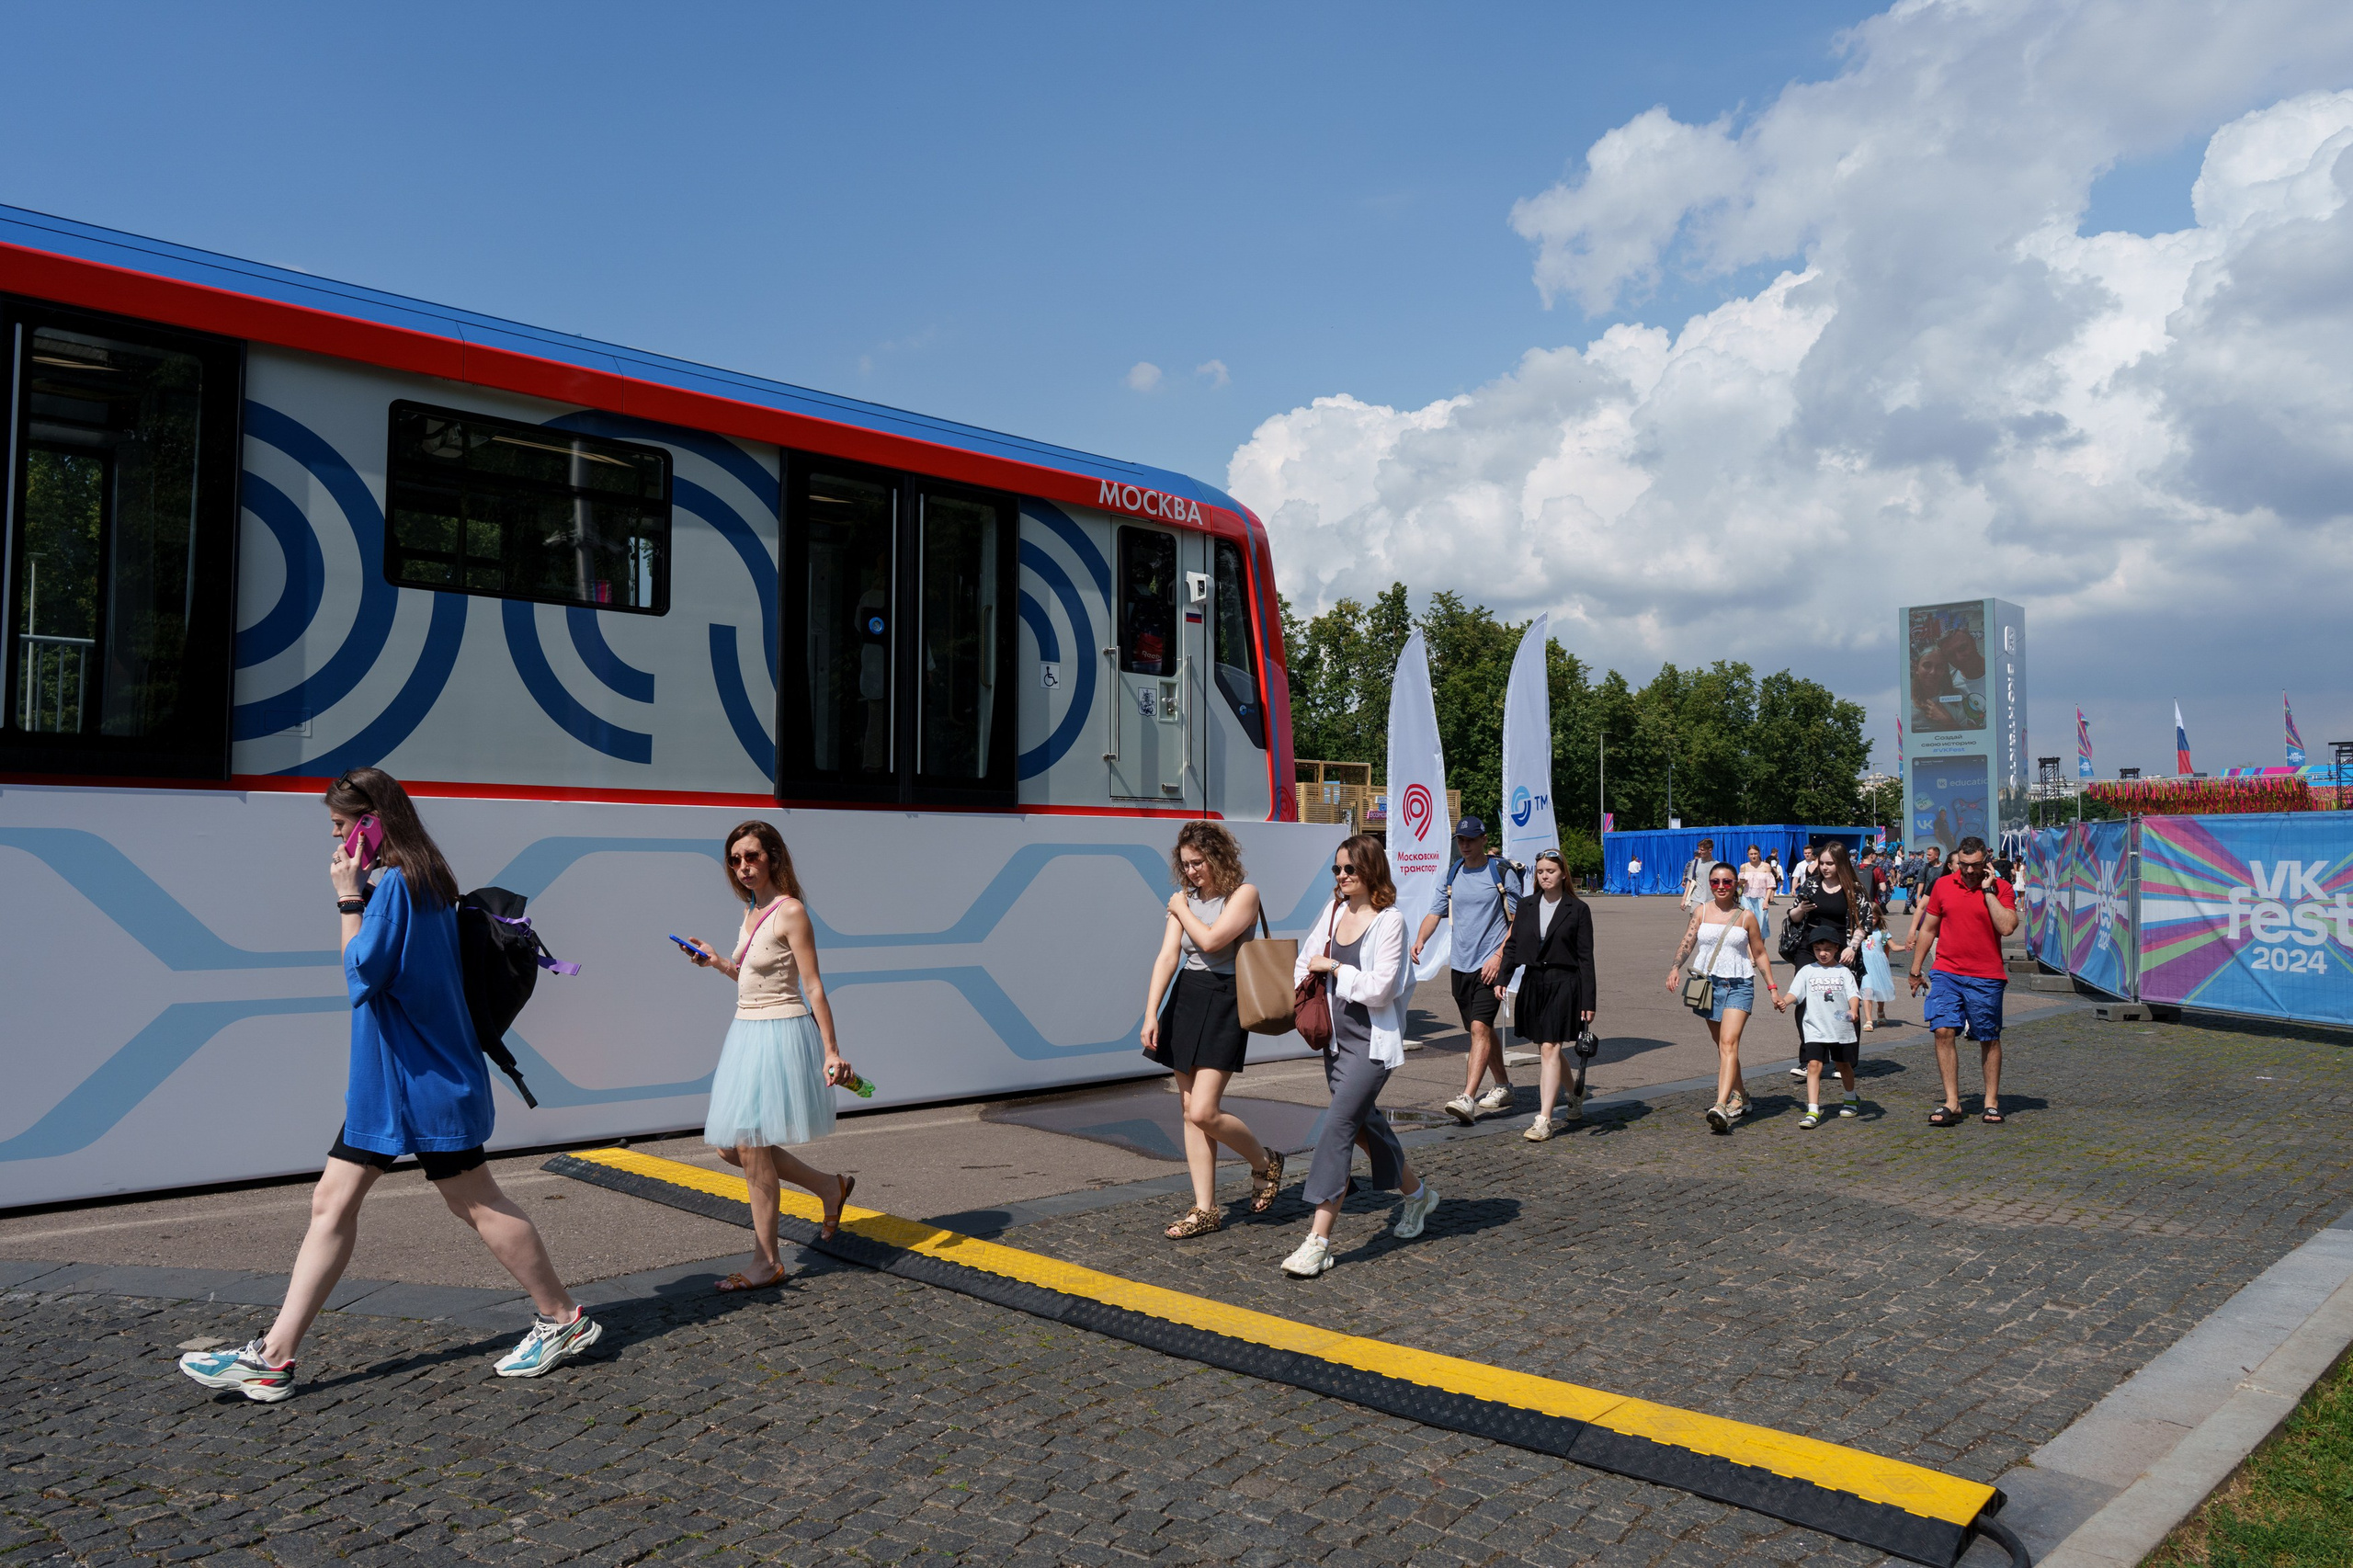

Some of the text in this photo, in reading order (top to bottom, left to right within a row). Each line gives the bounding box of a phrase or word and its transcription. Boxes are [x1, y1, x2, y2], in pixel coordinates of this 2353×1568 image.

[1098, 480, 1203, 526] МОСКВА
[1142, 650, 1162, 660] Reeb
[1534, 794, 1549, 811] ТМ
[1916, 819, 1934, 830] VK
[1397, 850, 1439, 861] Московский
[1400, 865, 1438, 876] транспорт
[2100, 859, 2116, 894] VK
[2248, 860, 2330, 901] VK
[2227, 886, 2353, 947] fest
[2251, 946, 2327, 975] 2024
